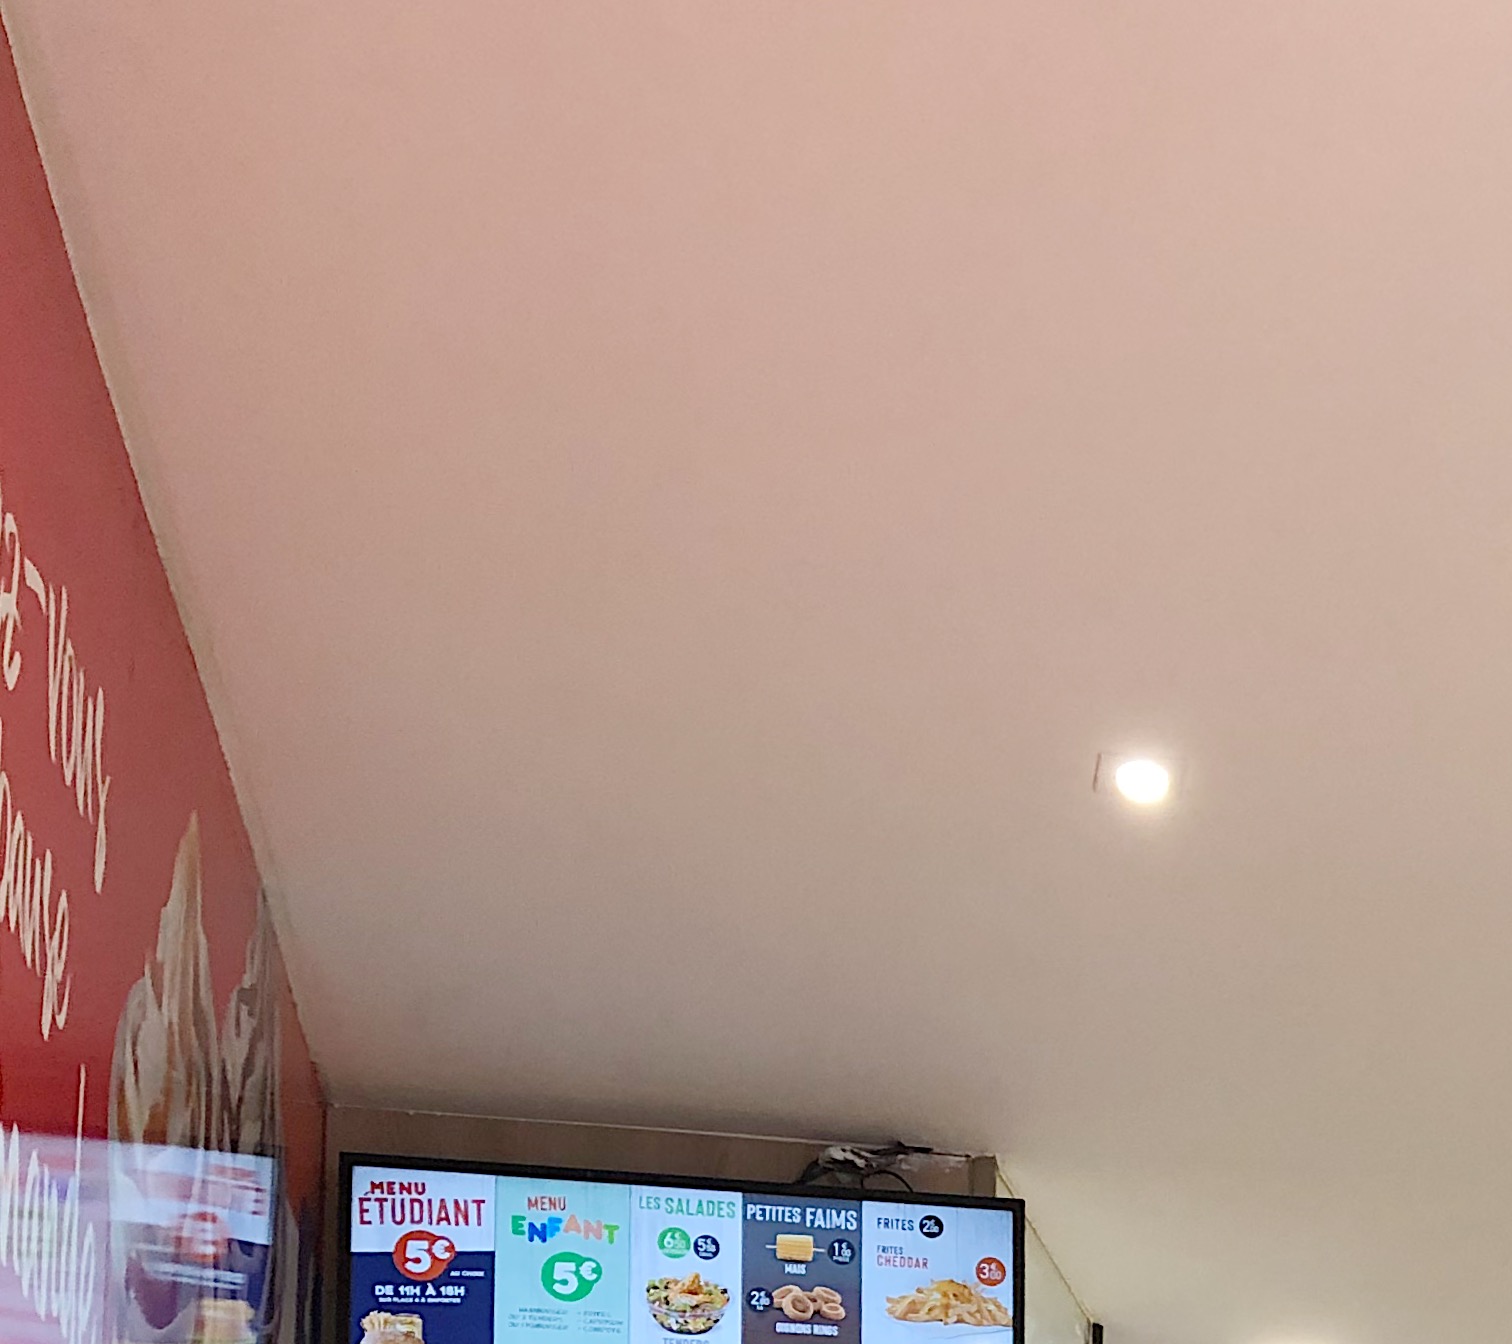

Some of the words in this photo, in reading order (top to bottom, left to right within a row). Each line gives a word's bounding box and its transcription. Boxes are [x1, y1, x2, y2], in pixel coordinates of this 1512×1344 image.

[369, 1180, 427, 1196] MENU
[358, 1190, 487, 1227] ÉTUDIANT
[527, 1196, 567, 1212] MENU
[639, 1196, 661, 1211] LES
[664, 1197, 737, 1219] SALADES
[746, 1203, 801, 1224] PETITES
[804, 1207, 858, 1231] FAIMS
[877, 1217, 914, 1231] FRITES
[511, 1214, 620, 1245] ENFANT
[404, 1239, 451, 1274] 5€
[876, 1245, 904, 1255] FRITES
[876, 1255, 929, 1270] CHEDDAR
[552, 1261, 598, 1295] 5€
[374, 1285, 395, 1296] DE
[398, 1285, 421, 1297] 11H
[424, 1282, 437, 1297] À
